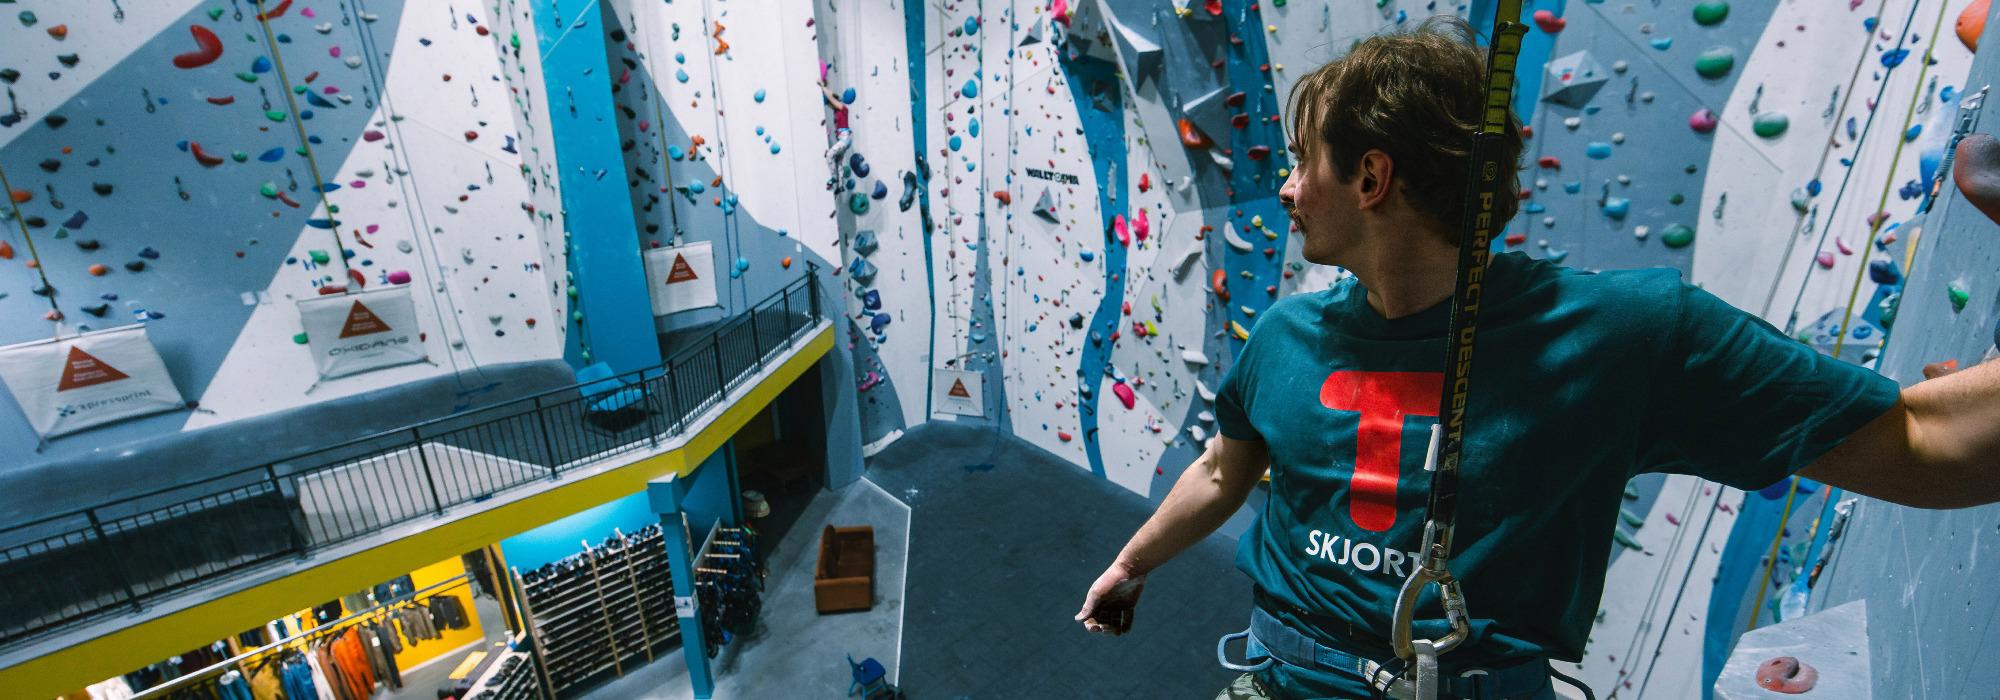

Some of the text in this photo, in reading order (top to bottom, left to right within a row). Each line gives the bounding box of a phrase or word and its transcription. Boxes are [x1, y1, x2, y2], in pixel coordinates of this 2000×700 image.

[1448, 192, 1495, 442] PERFECT DESCENT
[1319, 370, 1445, 532] T
